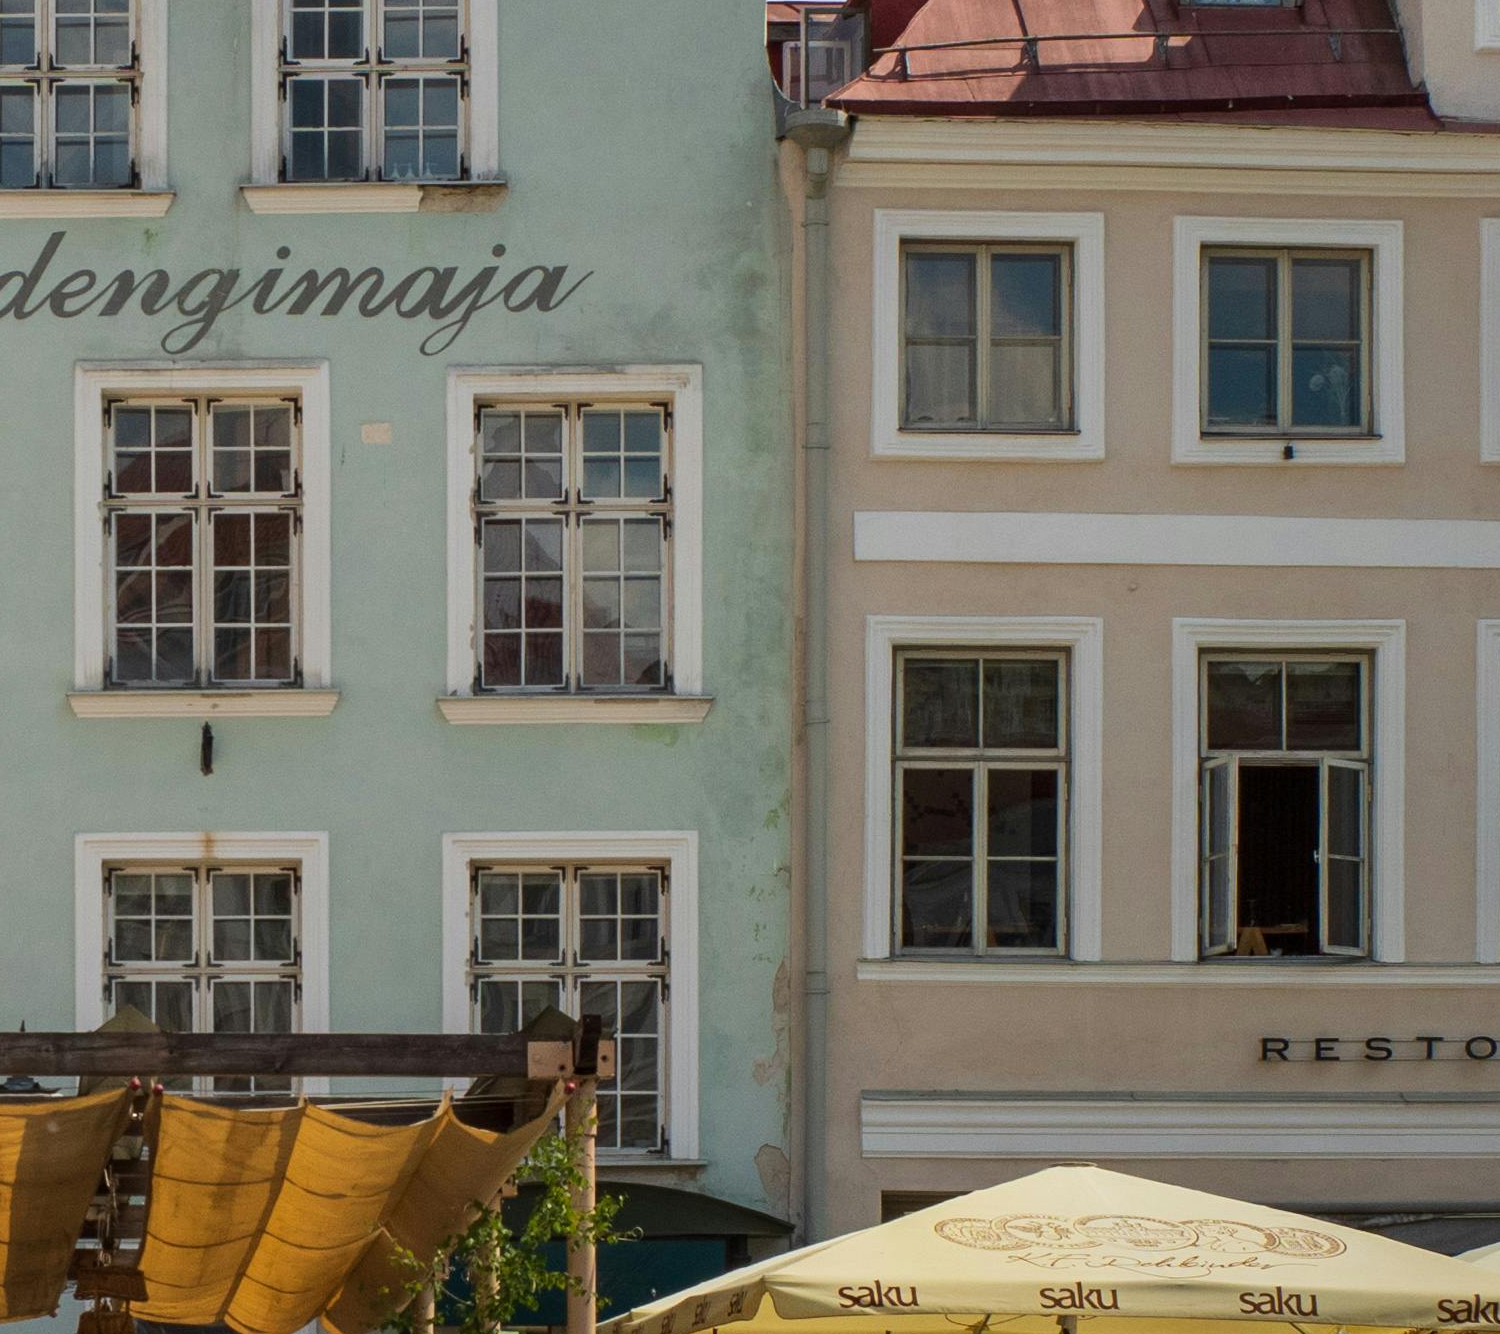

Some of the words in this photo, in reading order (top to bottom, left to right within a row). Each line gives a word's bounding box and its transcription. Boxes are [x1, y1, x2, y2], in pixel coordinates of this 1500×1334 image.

[838, 1280, 918, 1308] saku
[1040, 1281, 1120, 1310] saku
[1239, 1286, 1318, 1317] saku
